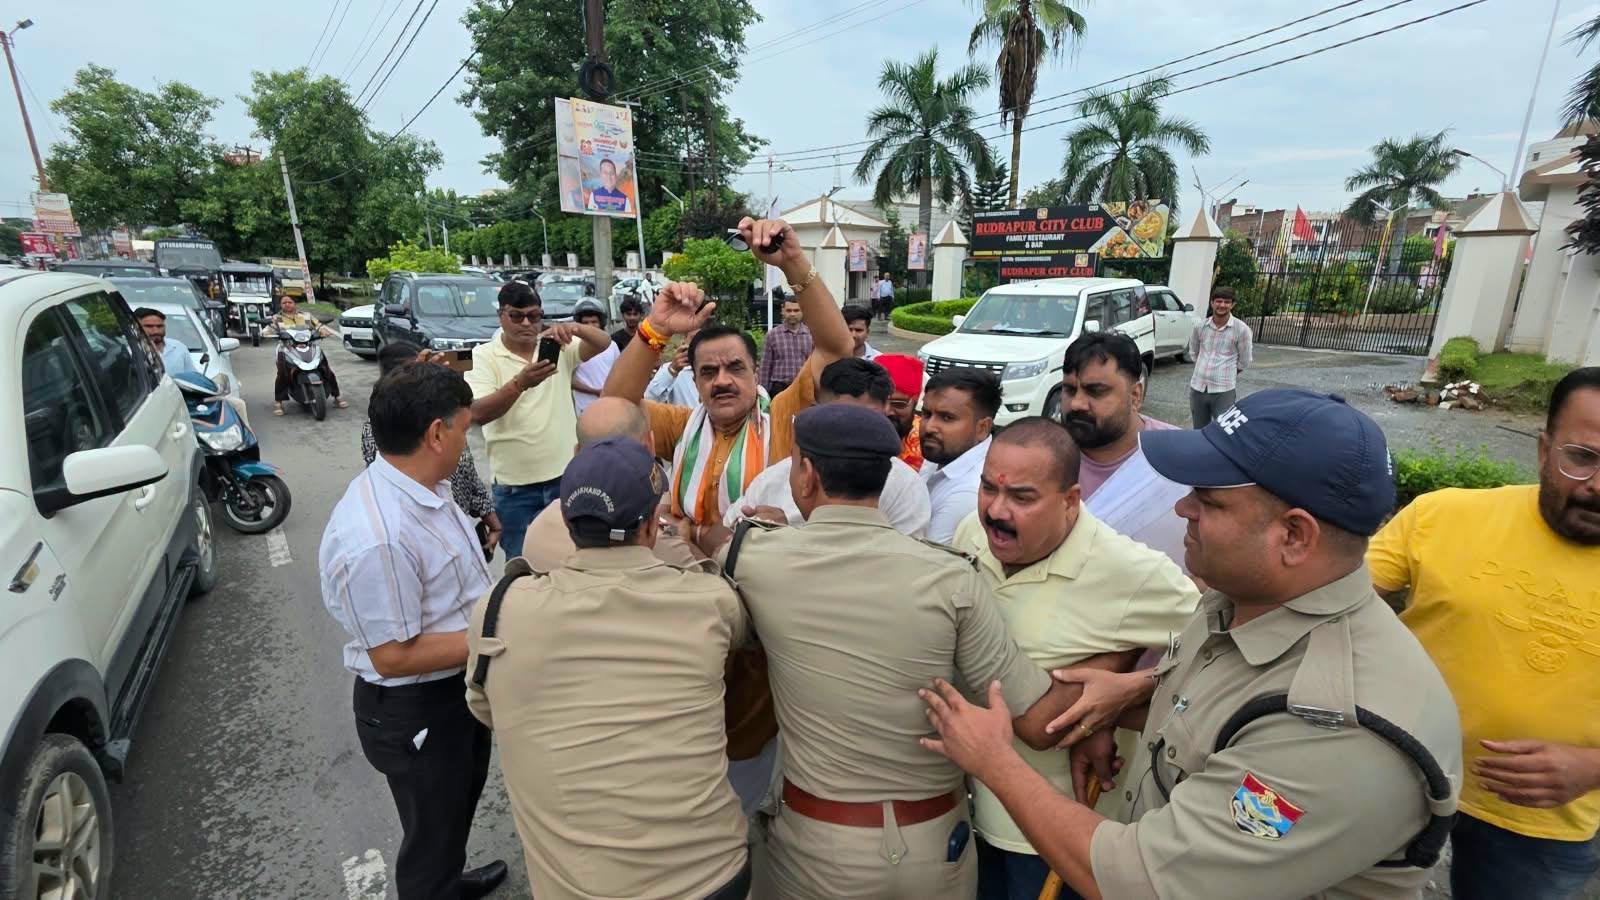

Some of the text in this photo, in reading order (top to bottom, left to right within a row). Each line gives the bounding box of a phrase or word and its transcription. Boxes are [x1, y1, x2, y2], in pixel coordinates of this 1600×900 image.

[976, 217, 1104, 234] RUDRAPUR CITY CLUB
[1028, 233, 1065, 241] RESTAURANT
[1002, 267, 1093, 277] RUDRAPUR CITY CLUB
[600, 491, 615, 513] POLICE
